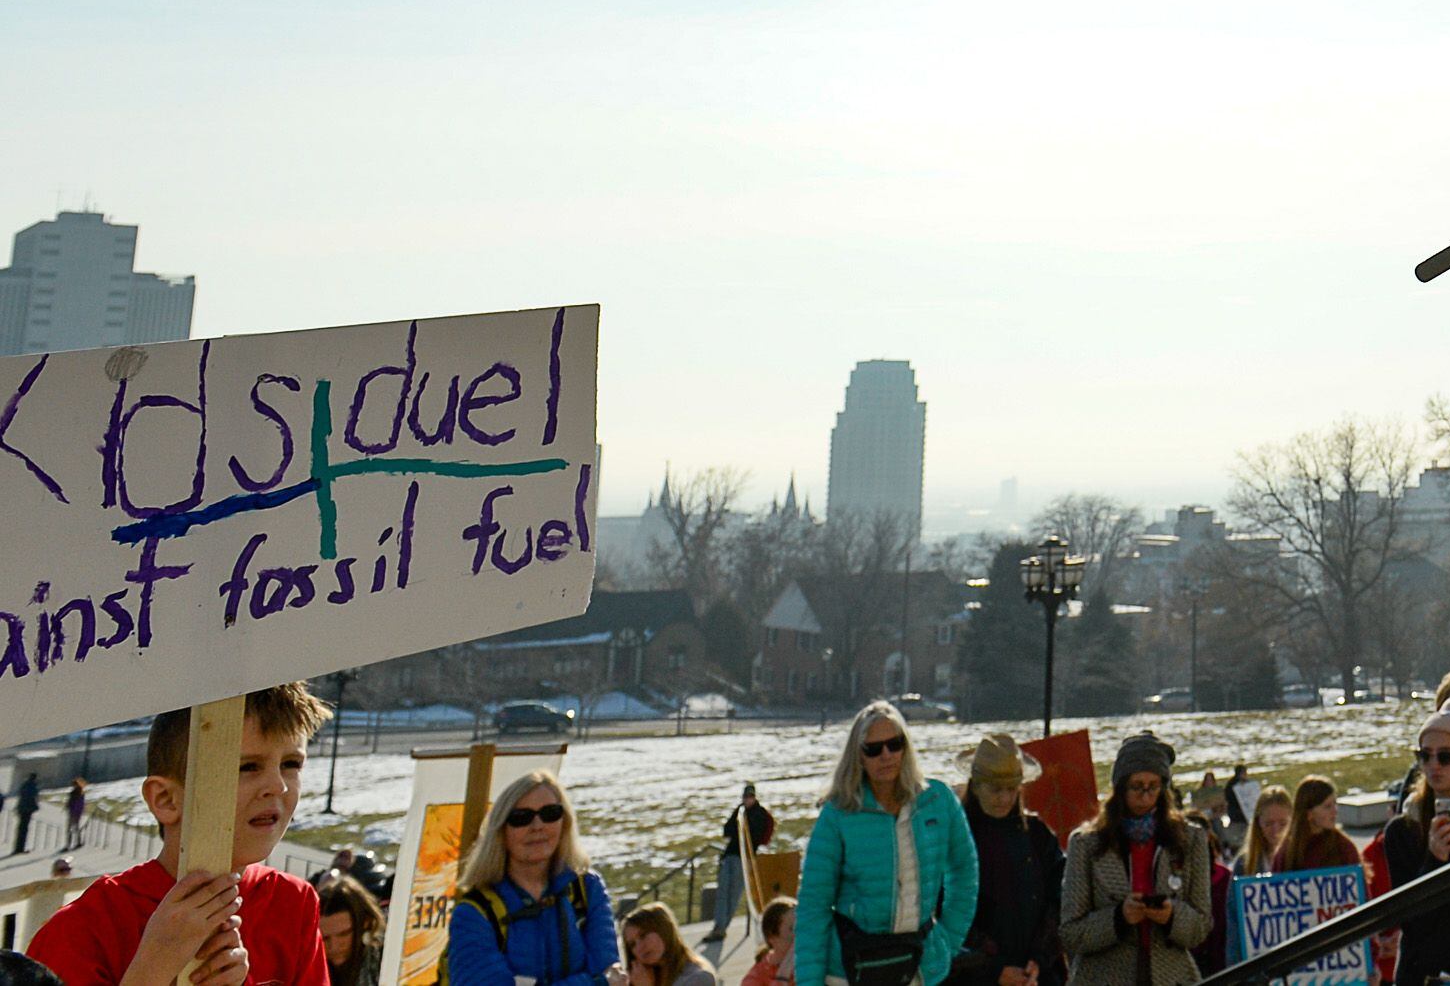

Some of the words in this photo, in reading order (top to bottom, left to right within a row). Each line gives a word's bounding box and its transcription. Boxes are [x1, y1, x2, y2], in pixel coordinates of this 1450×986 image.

[344, 307, 566, 454] duel
[219, 480, 419, 629] fossil
[462, 464, 591, 575] fuel
[1243, 878, 1312, 913] RAISE
[1313, 875, 1358, 905] YOUR
[1246, 908, 1314, 950] VOICE
